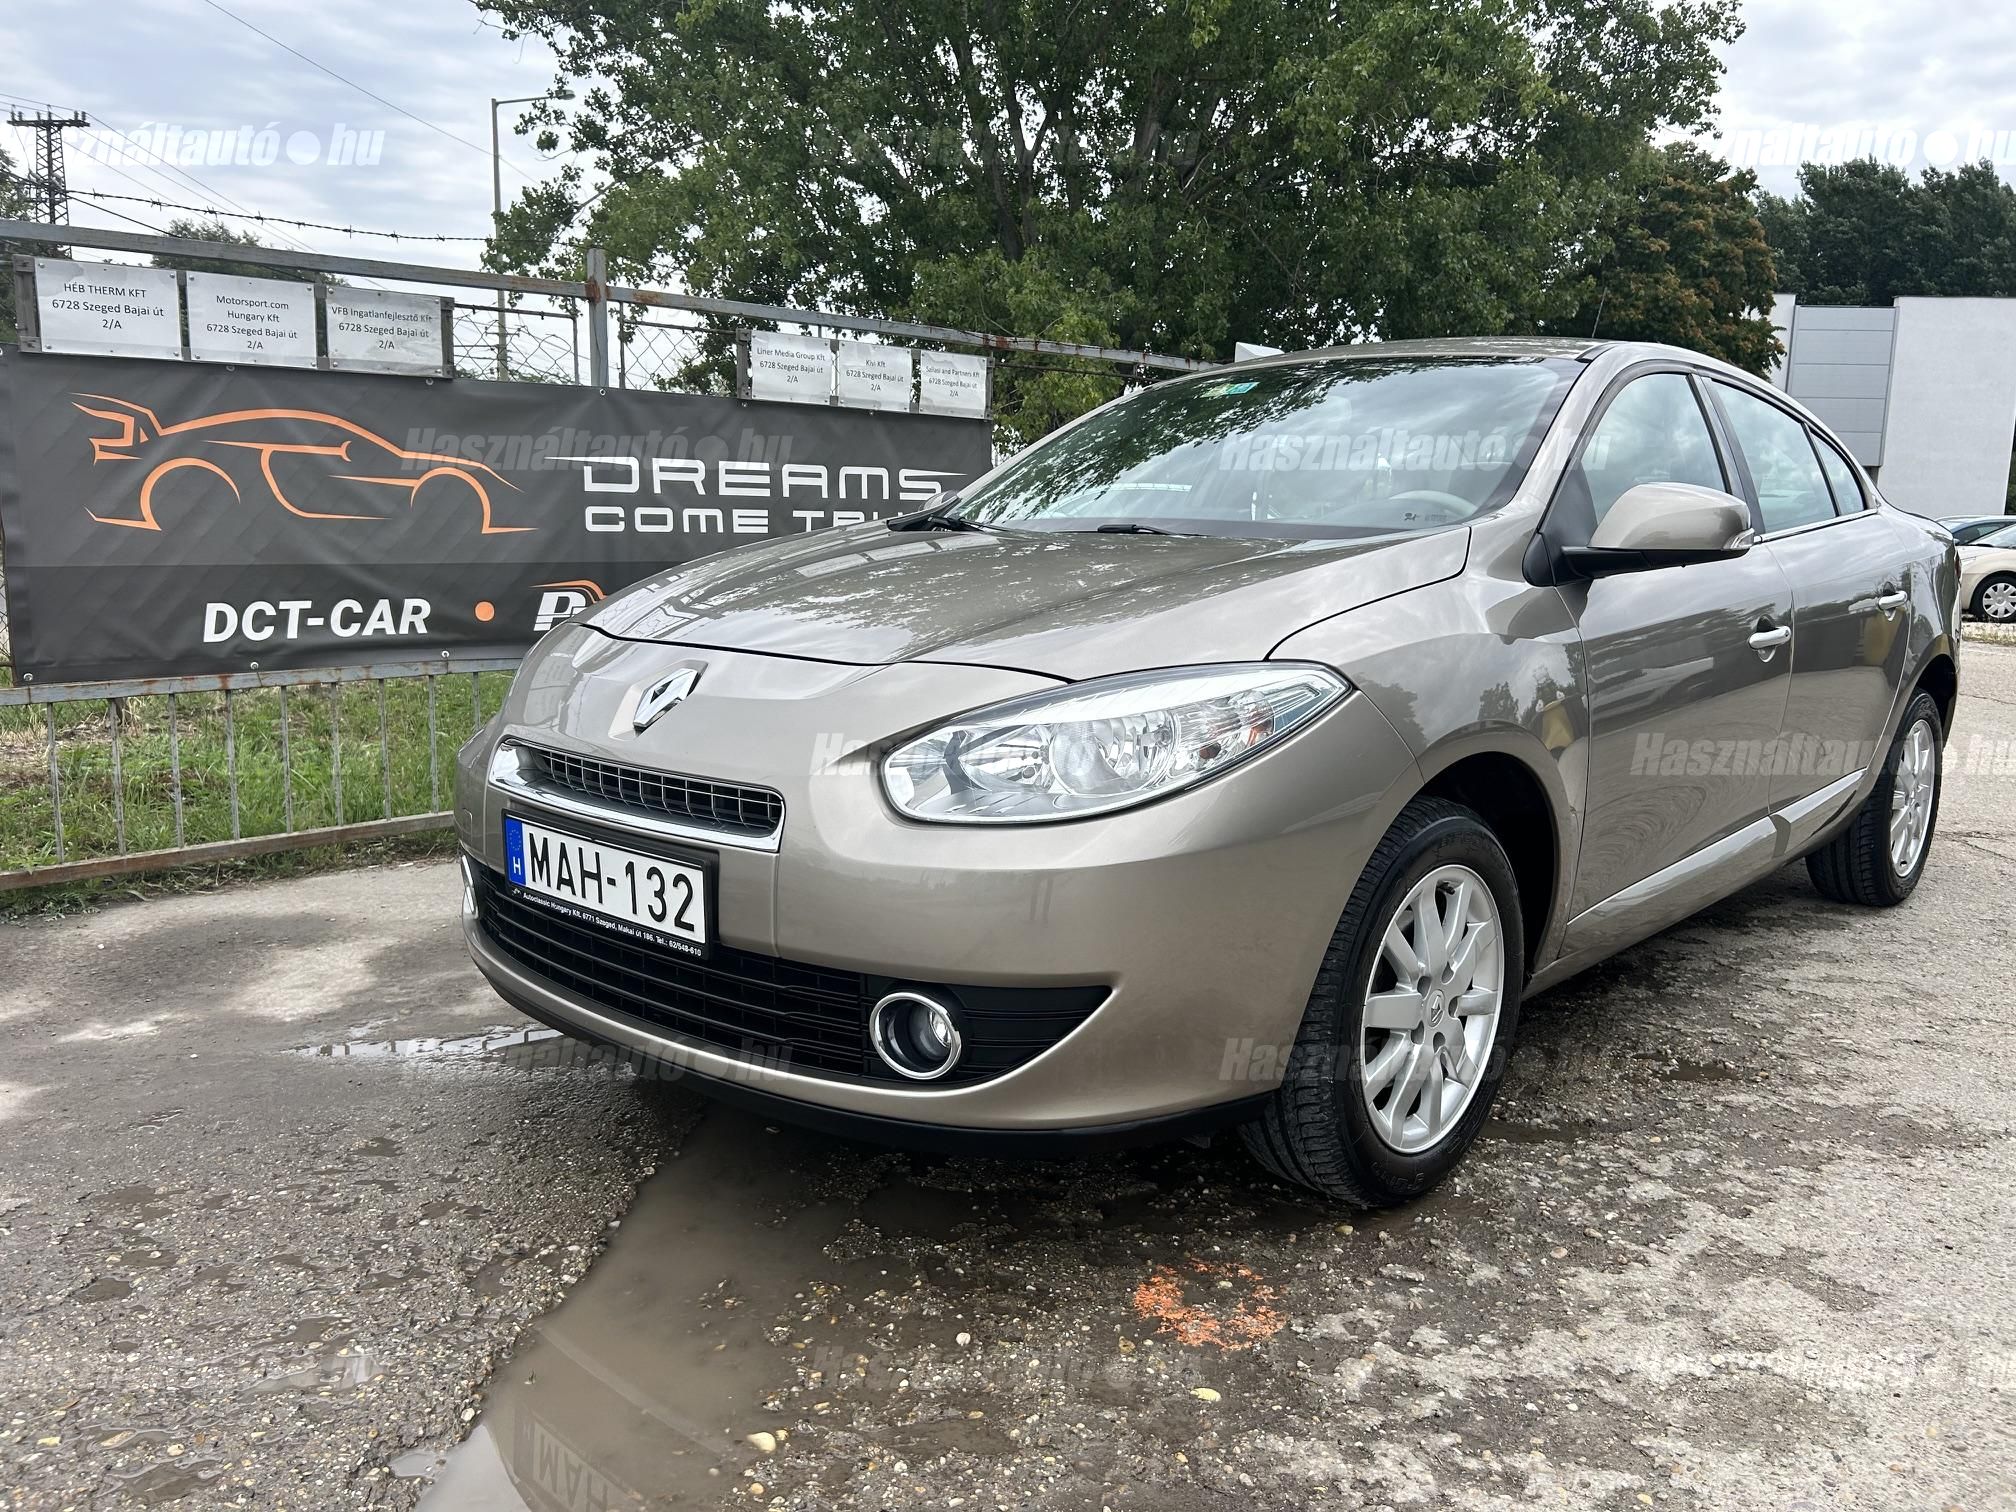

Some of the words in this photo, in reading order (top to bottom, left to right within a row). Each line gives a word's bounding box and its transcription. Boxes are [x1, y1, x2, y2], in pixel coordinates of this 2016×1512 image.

[64, 282, 85, 293] HÉB
[88, 285, 125, 297] THERM
[128, 288, 147, 298] KFT
[52, 299, 80, 310] 6728
[83, 301, 121, 314] Szeged
[124, 305, 150, 317] Bajai
[153, 306, 165, 317] út
[216, 295, 289, 310] Motorsport.com
[227, 310, 265, 322] Hungary
[267, 314, 280, 323] Kft
[331, 306, 348, 316] VFB
[350, 308, 418, 322] Ingatlanfejlesztő
[420, 314, 432, 323] Kft
[102, 319, 122, 330] 2/A
[206, 323, 229, 333] 6728
[232, 325, 263, 336] Szeged
[265, 328, 286, 338] Bajai
[288, 329, 298, 339] út
[338, 322, 362, 333] 6728
[364, 324, 394, 336] Szeged
[397, 327, 418, 338] Bajai
[420, 329, 429, 338] út
[247, 341, 264, 350] 2/A
[379, 340, 395, 350] 2/A
[774, 349, 795, 359] Media
[796, 352, 816, 361] Group
[759, 360, 776, 369] 6728
[777, 362, 799, 372] Szeged
[800, 364, 816, 374] Bajai
[786, 375, 799, 384] 2/A
[846, 369, 861, 378] 6728
[862, 371, 882, 381] Szeged
[870, 383, 881, 392] 2/A
[928, 377, 942, 385] 6728
[942, 379, 959, 388] Szeged
[543, 456, 968, 501] DREAMS
[585, 505, 770, 534] COME
[203, 598, 431, 643] DCT-CAR
[512, 856, 522, 876] H
[529, 833, 695, 932] MAH-132
